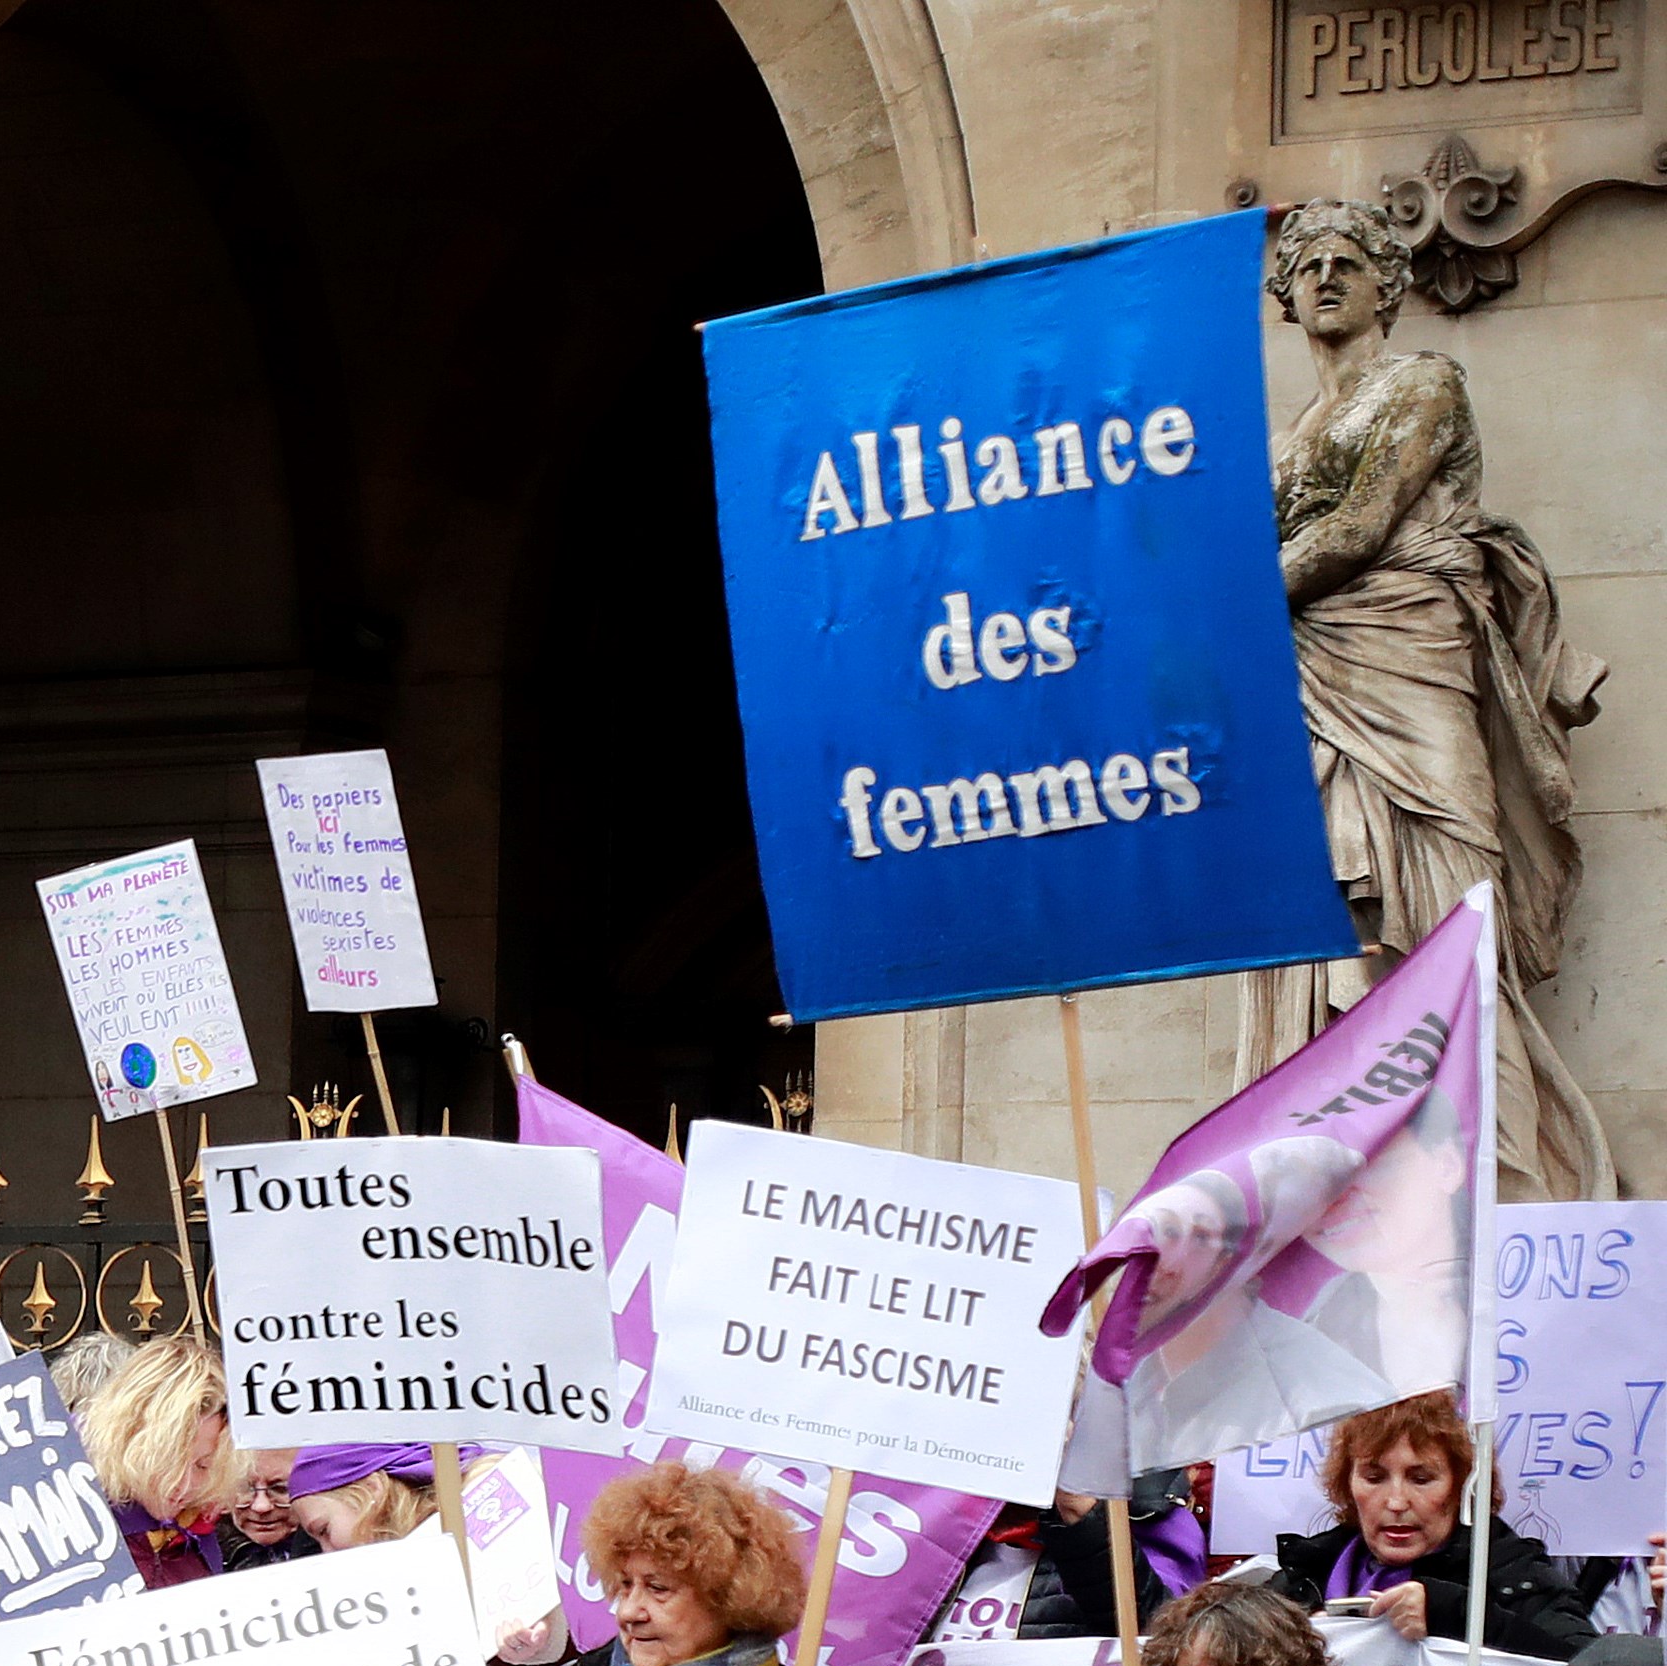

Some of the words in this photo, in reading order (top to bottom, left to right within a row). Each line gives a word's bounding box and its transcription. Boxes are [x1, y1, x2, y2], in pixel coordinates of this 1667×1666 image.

[799, 403, 1196, 542] Alliance
[921, 590, 1079, 691] des
[277, 782, 305, 809] Des
[312, 783, 382, 818] papiers
[838, 745, 1203, 859] femmes
[46, 892, 79, 915] SUR
[87, 882, 114, 903] MA
[292, 864, 368, 893] victimes
[380, 866, 403, 892] de
[297, 898, 366, 928] violences
[67, 930, 103, 959] LES
[116, 917, 184, 947] FEMMES
[68, 961, 100, 985] LES
[109, 938, 190, 976] HOMMES
[322, 930, 397, 952] sexistes
[317, 954, 379, 987] ailleurs
[88, 1006, 181, 1044] VEULENT
[215, 1164, 413, 1215] Toutes
[361, 1216, 597, 1272] ensemble
[740, 1179, 788, 1221] LE
[798, 1188, 1039, 1265] MACHISME
[767, 1255, 860, 1305] FAIT
[867, 1272, 913, 1316] LE
[921, 1282, 987, 1327] LIT
[233, 1304, 385, 1344] contre
[395, 1298, 460, 1339] les
[721, 1319, 789, 1365] DU
[799, 1332, 1006, 1406] FASCISME
[241, 1360, 613, 1425] féminicides
[677, 1395, 746, 1421] Alliance
[749, 1406, 781, 1428] des
[785, 1413, 853, 1441] Femmes
[854, 1427, 899, 1451] pour
[903, 1434, 918, 1452] la
[923, 1439, 1026, 1473] Démocratie
